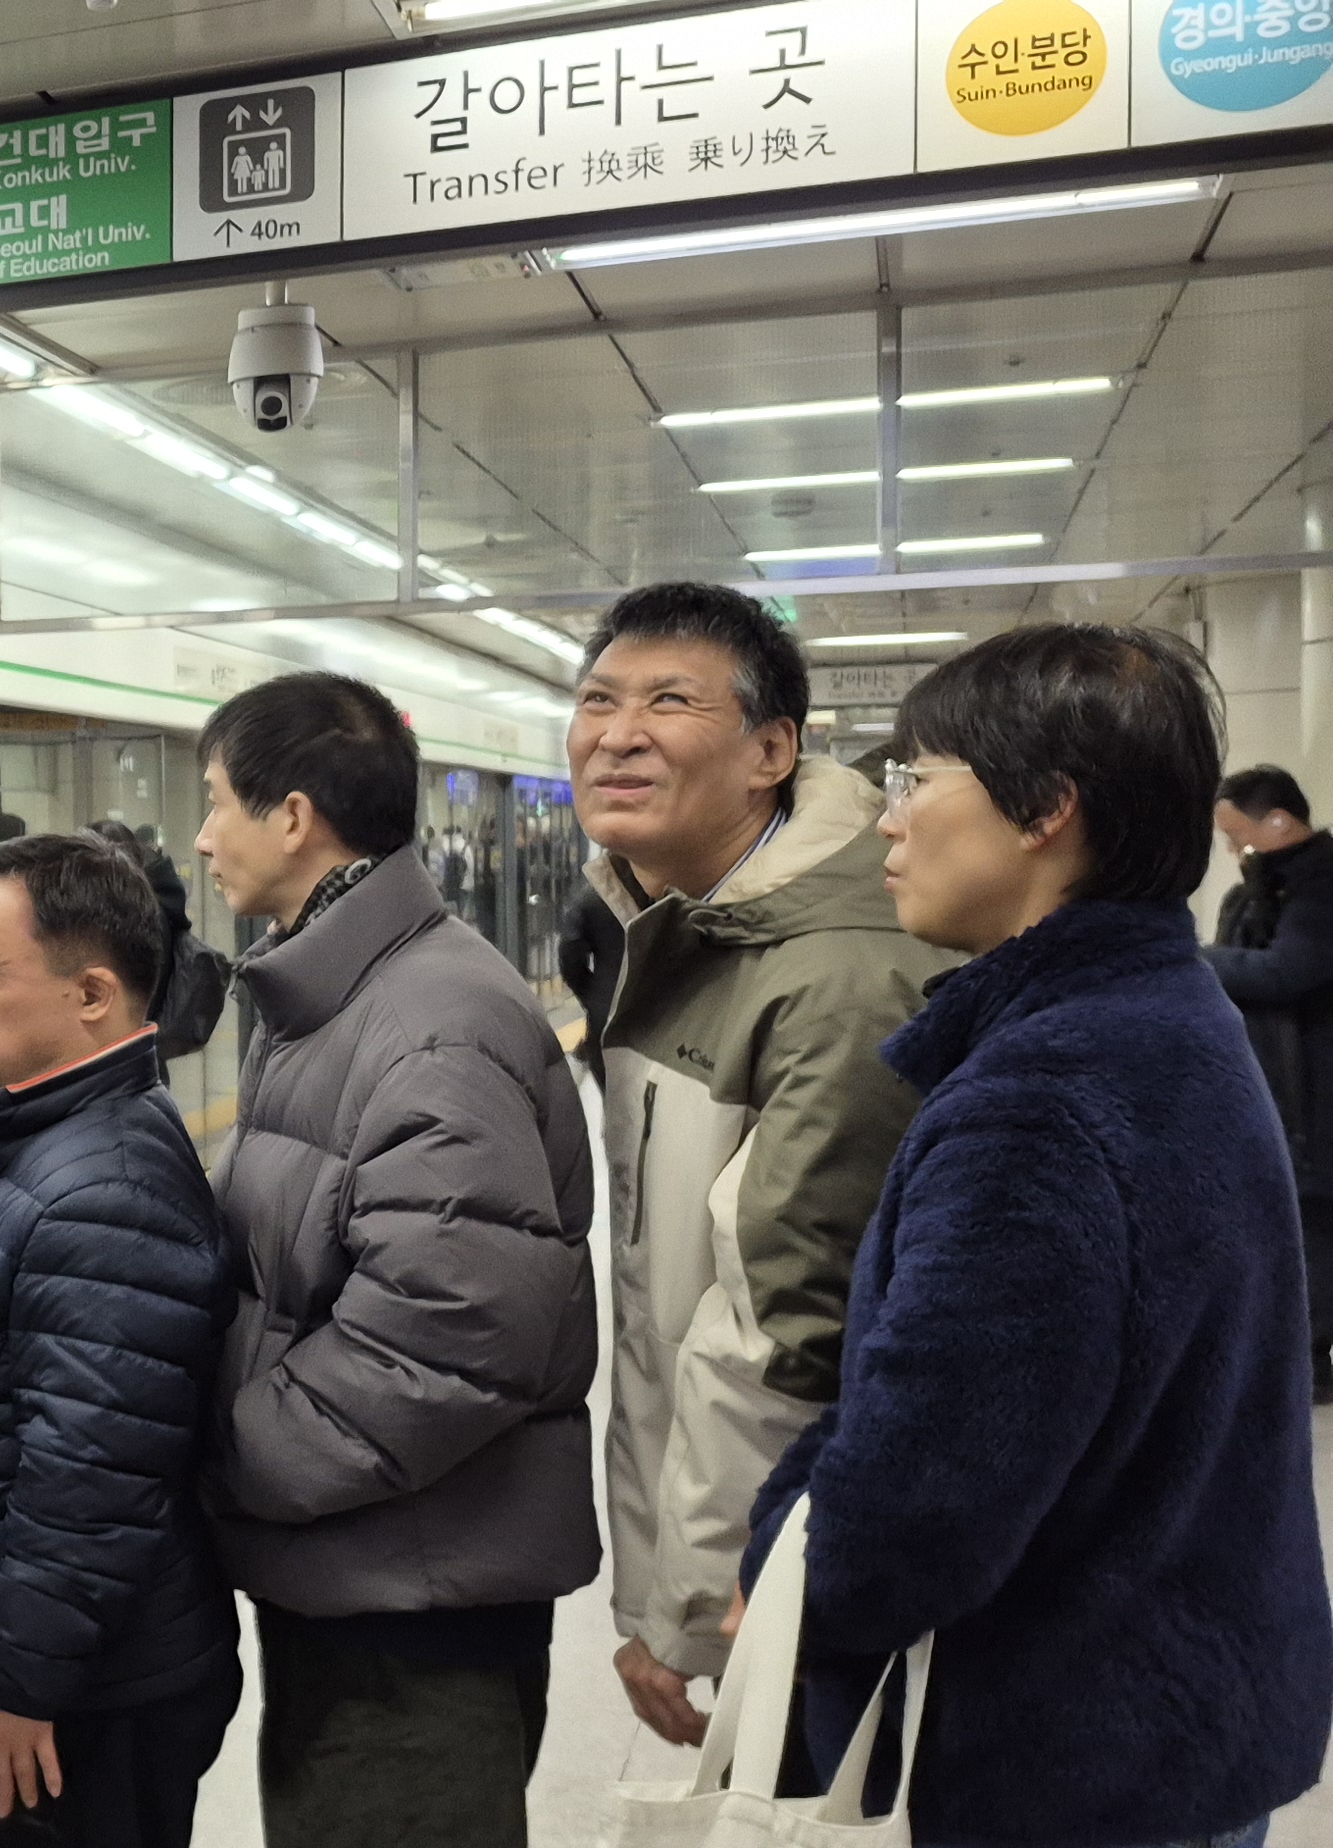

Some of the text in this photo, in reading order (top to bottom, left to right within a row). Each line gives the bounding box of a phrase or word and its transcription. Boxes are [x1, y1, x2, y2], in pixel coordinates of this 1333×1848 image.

[413, 25, 825, 154] 갈아타는 곳
[956, 74, 1093, 103] Suin·Bundang
[79, 155, 136, 178] Univ.
[403, 157, 565, 204] Transfer
[48, 228, 92, 251] Nat'l
[99, 222, 151, 245] Univ.
[249, 218, 301, 241] 40m
[10, 249, 109, 278] Education
